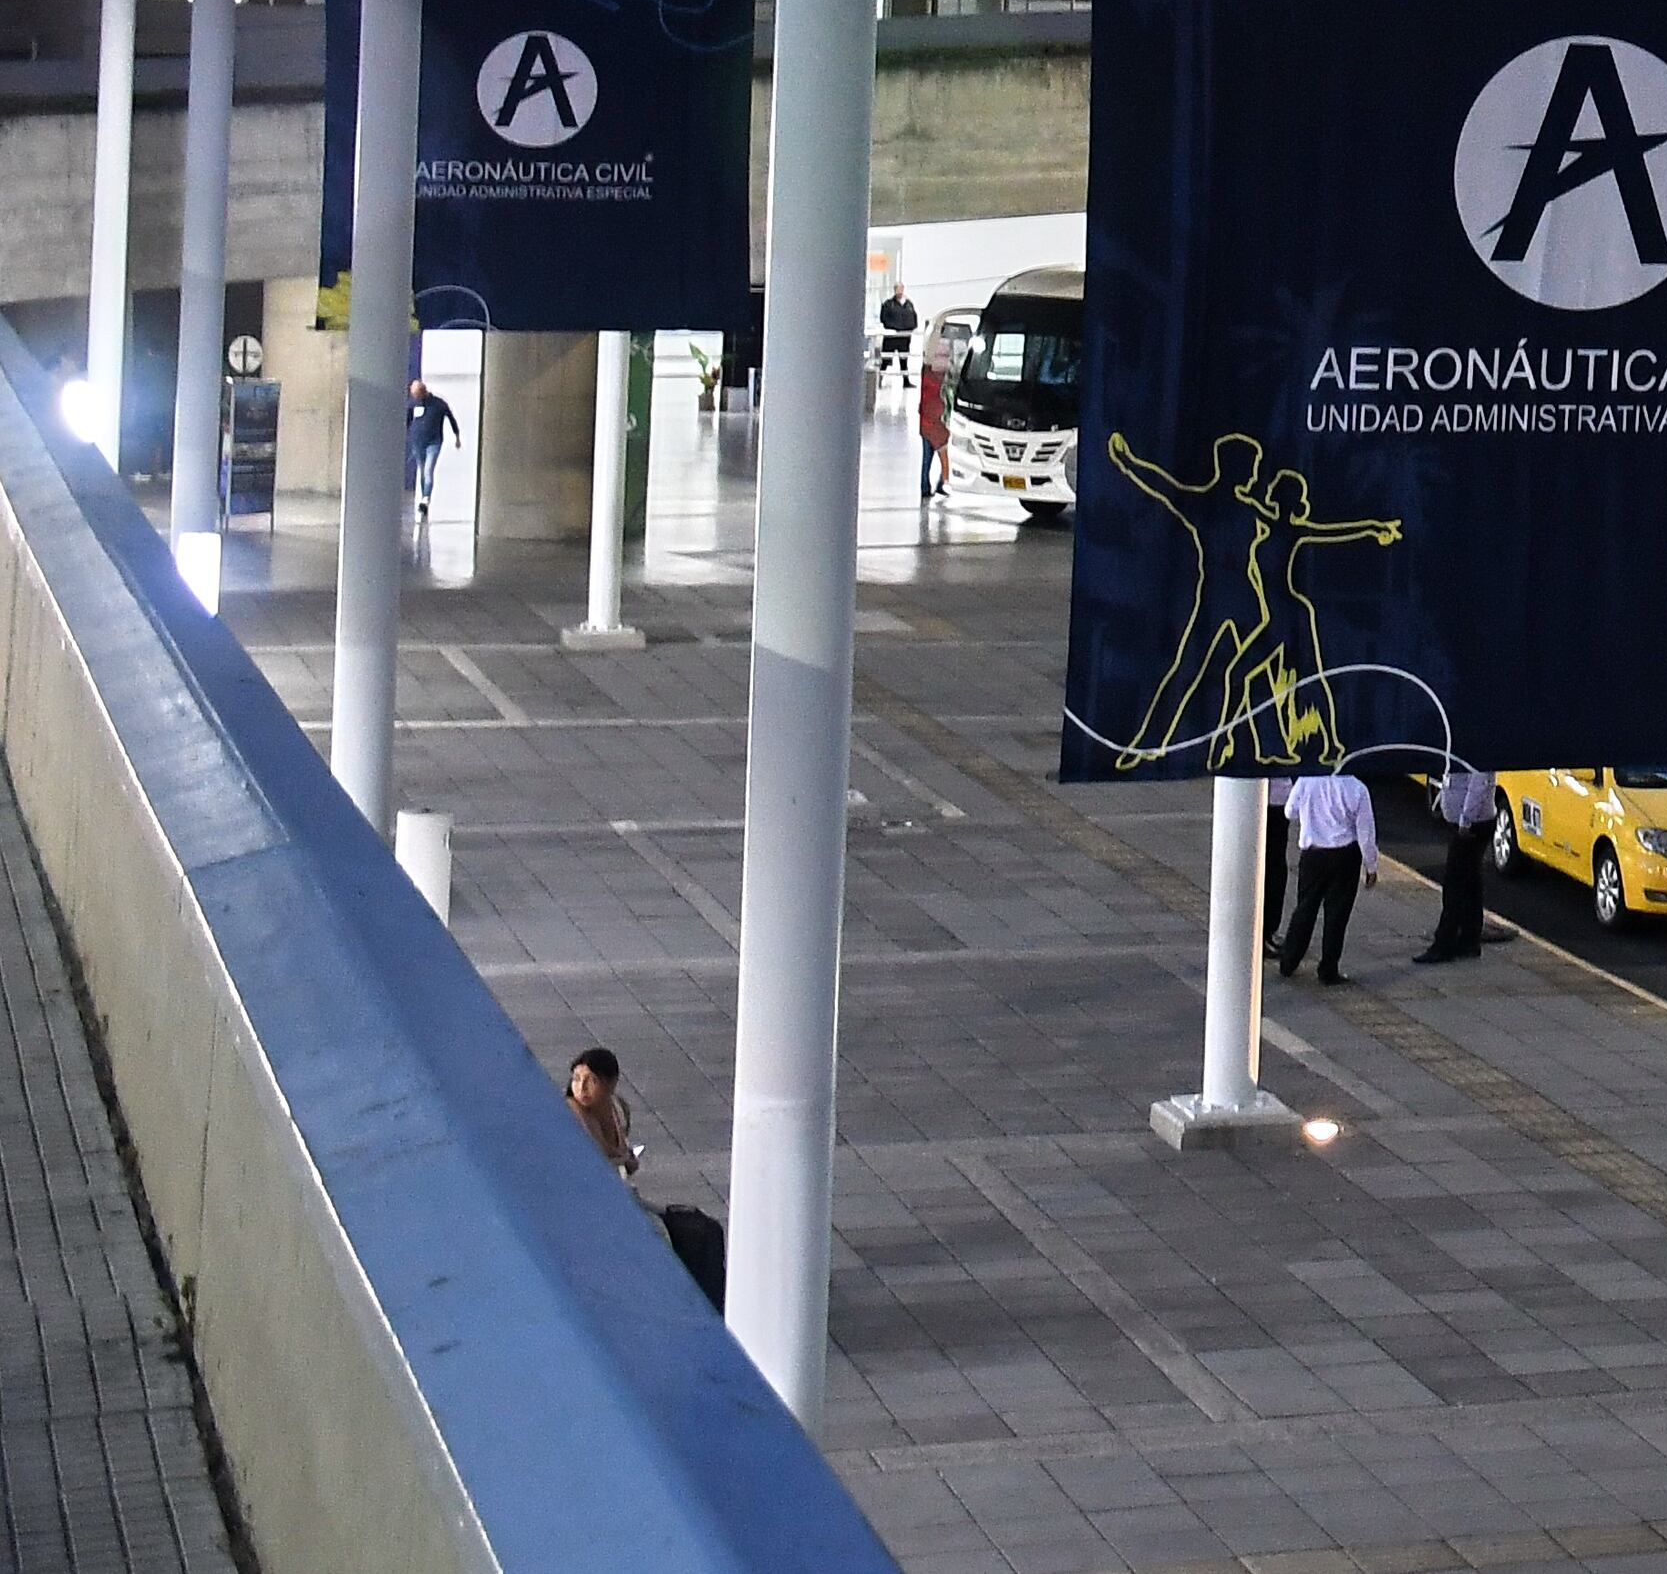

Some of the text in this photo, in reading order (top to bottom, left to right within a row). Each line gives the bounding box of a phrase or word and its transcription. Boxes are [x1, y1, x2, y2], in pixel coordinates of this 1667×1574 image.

[416, 157, 653, 183] AERONÁUTICA CIVIL
[1306, 403, 1424, 433] UNIDAD
